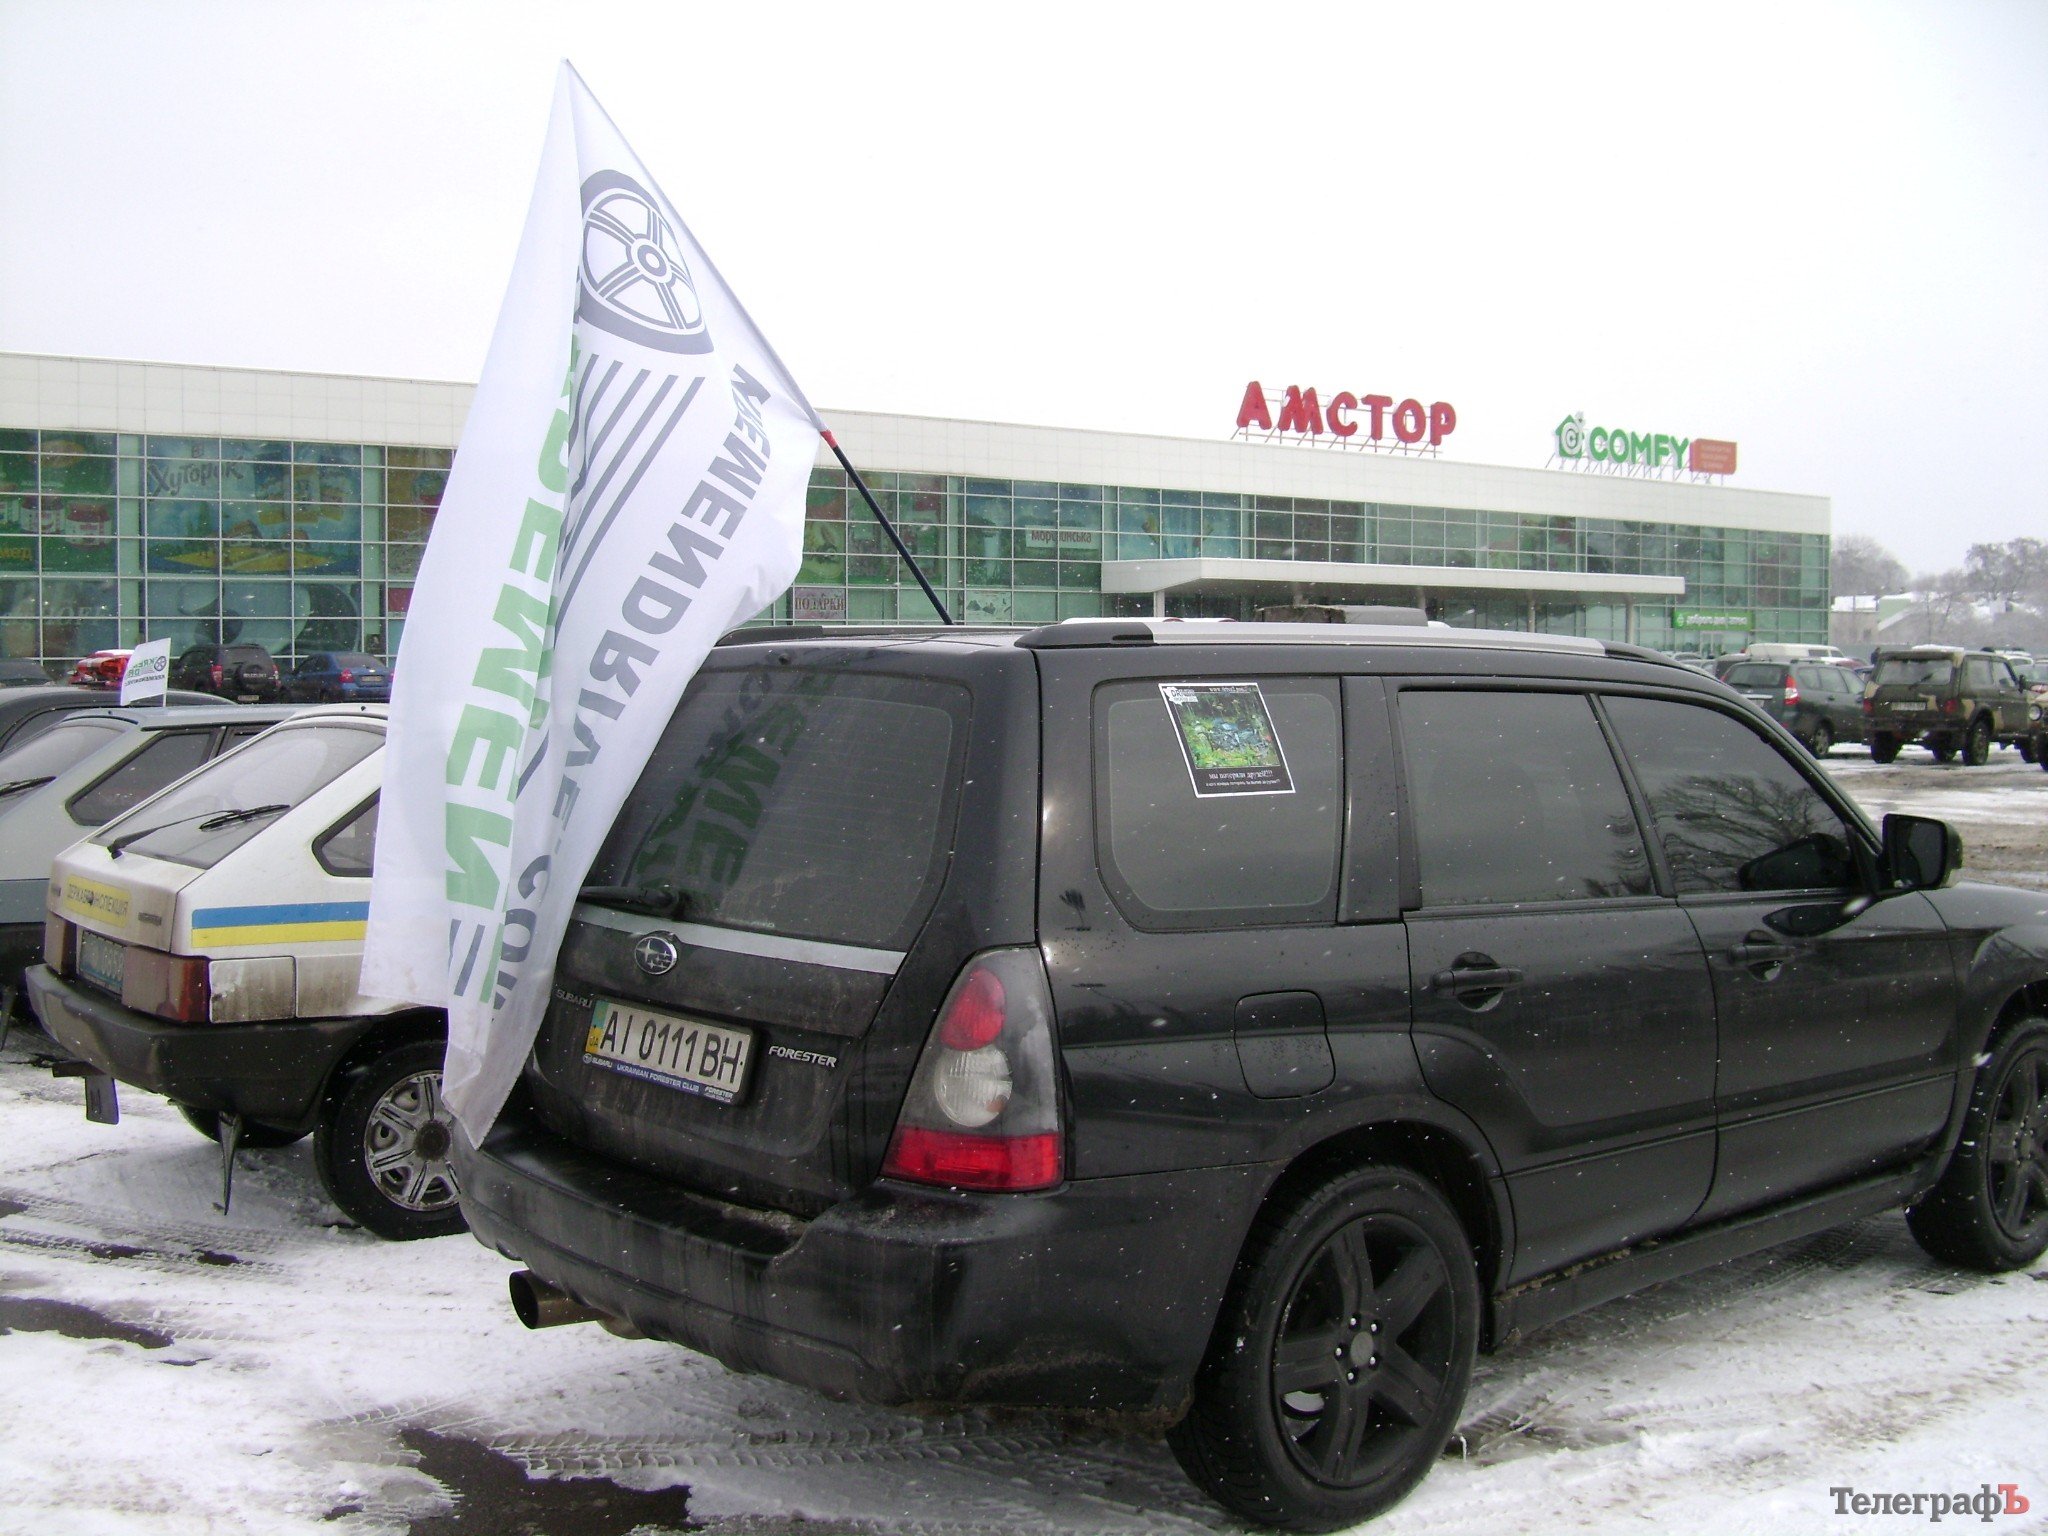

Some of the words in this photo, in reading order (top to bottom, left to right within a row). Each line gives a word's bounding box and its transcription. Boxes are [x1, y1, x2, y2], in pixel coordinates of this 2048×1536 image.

[1236, 380, 1456, 446] АМСТОР
[1589, 426, 1690, 470] COMFY
[768, 1044, 838, 1068] FORESTER
[616, 1063, 649, 1080] UKRAINIAN
[649, 1072, 681, 1089] FORESTER
[681, 1081, 700, 1093] CLUB
[704, 1085, 735, 1100] FORESTER
